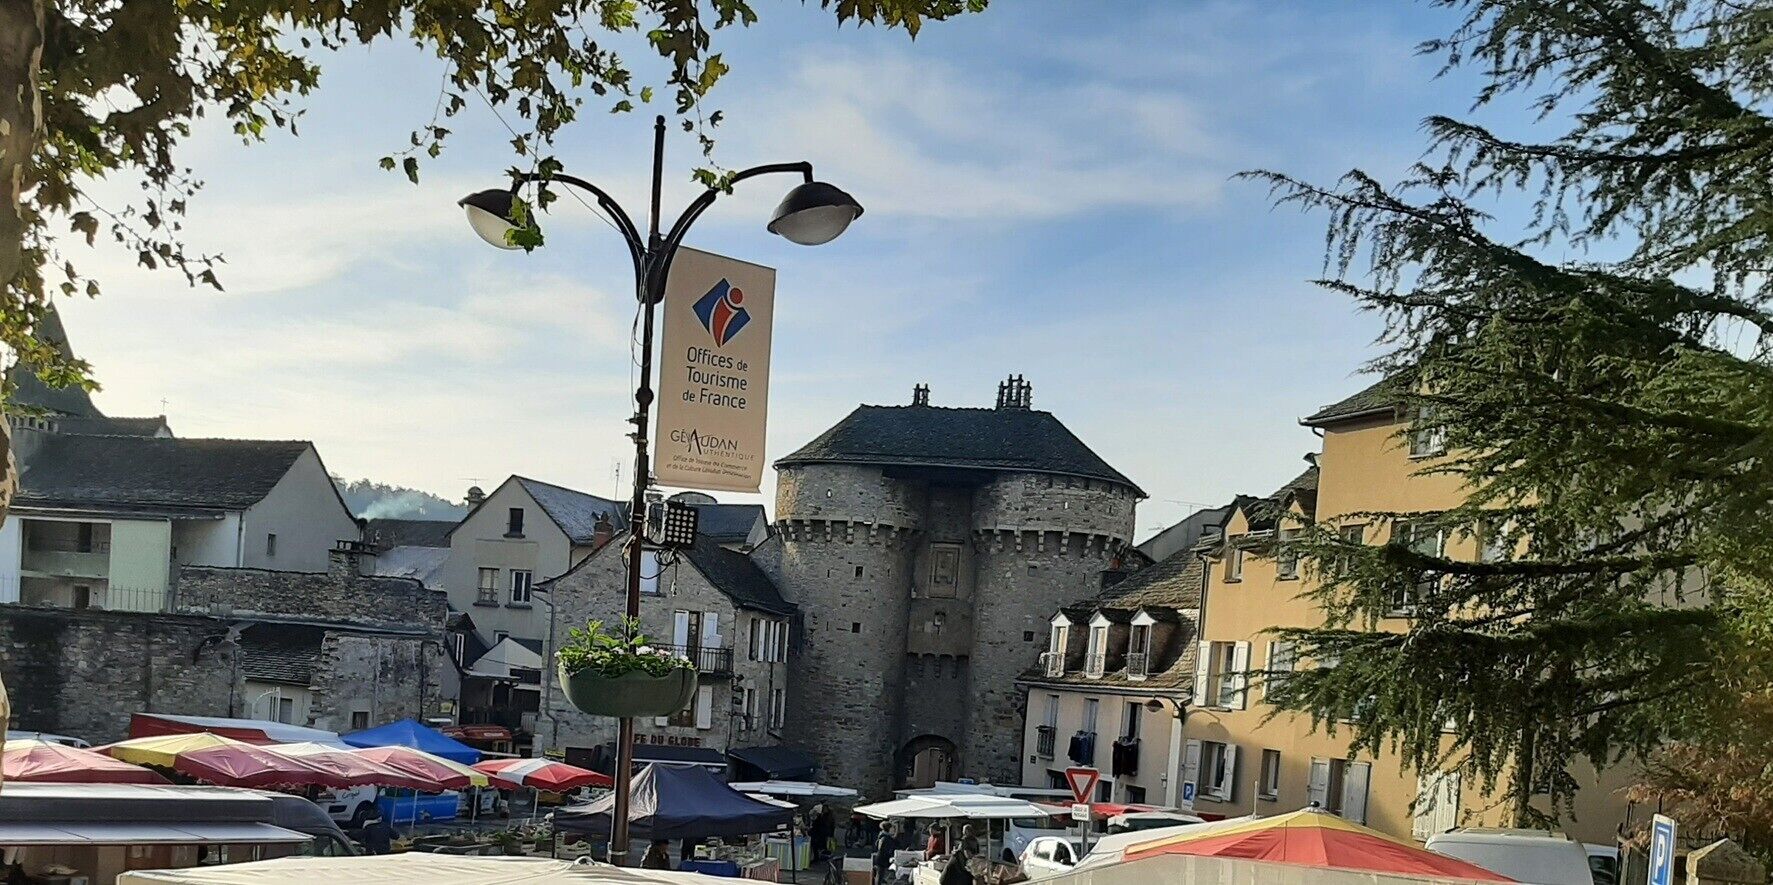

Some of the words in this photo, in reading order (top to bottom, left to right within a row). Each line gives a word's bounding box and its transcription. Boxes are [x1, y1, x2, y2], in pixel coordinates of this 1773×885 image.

[686, 346, 733, 369] Offices
[737, 360, 748, 372] de
[686, 366, 748, 390] Tourisme
[682, 390, 695, 402] de
[699, 388, 746, 409] France
[651, 735, 664, 744] DU
[668, 736, 701, 747] GLOBE
[1655, 834, 1666, 879] P
